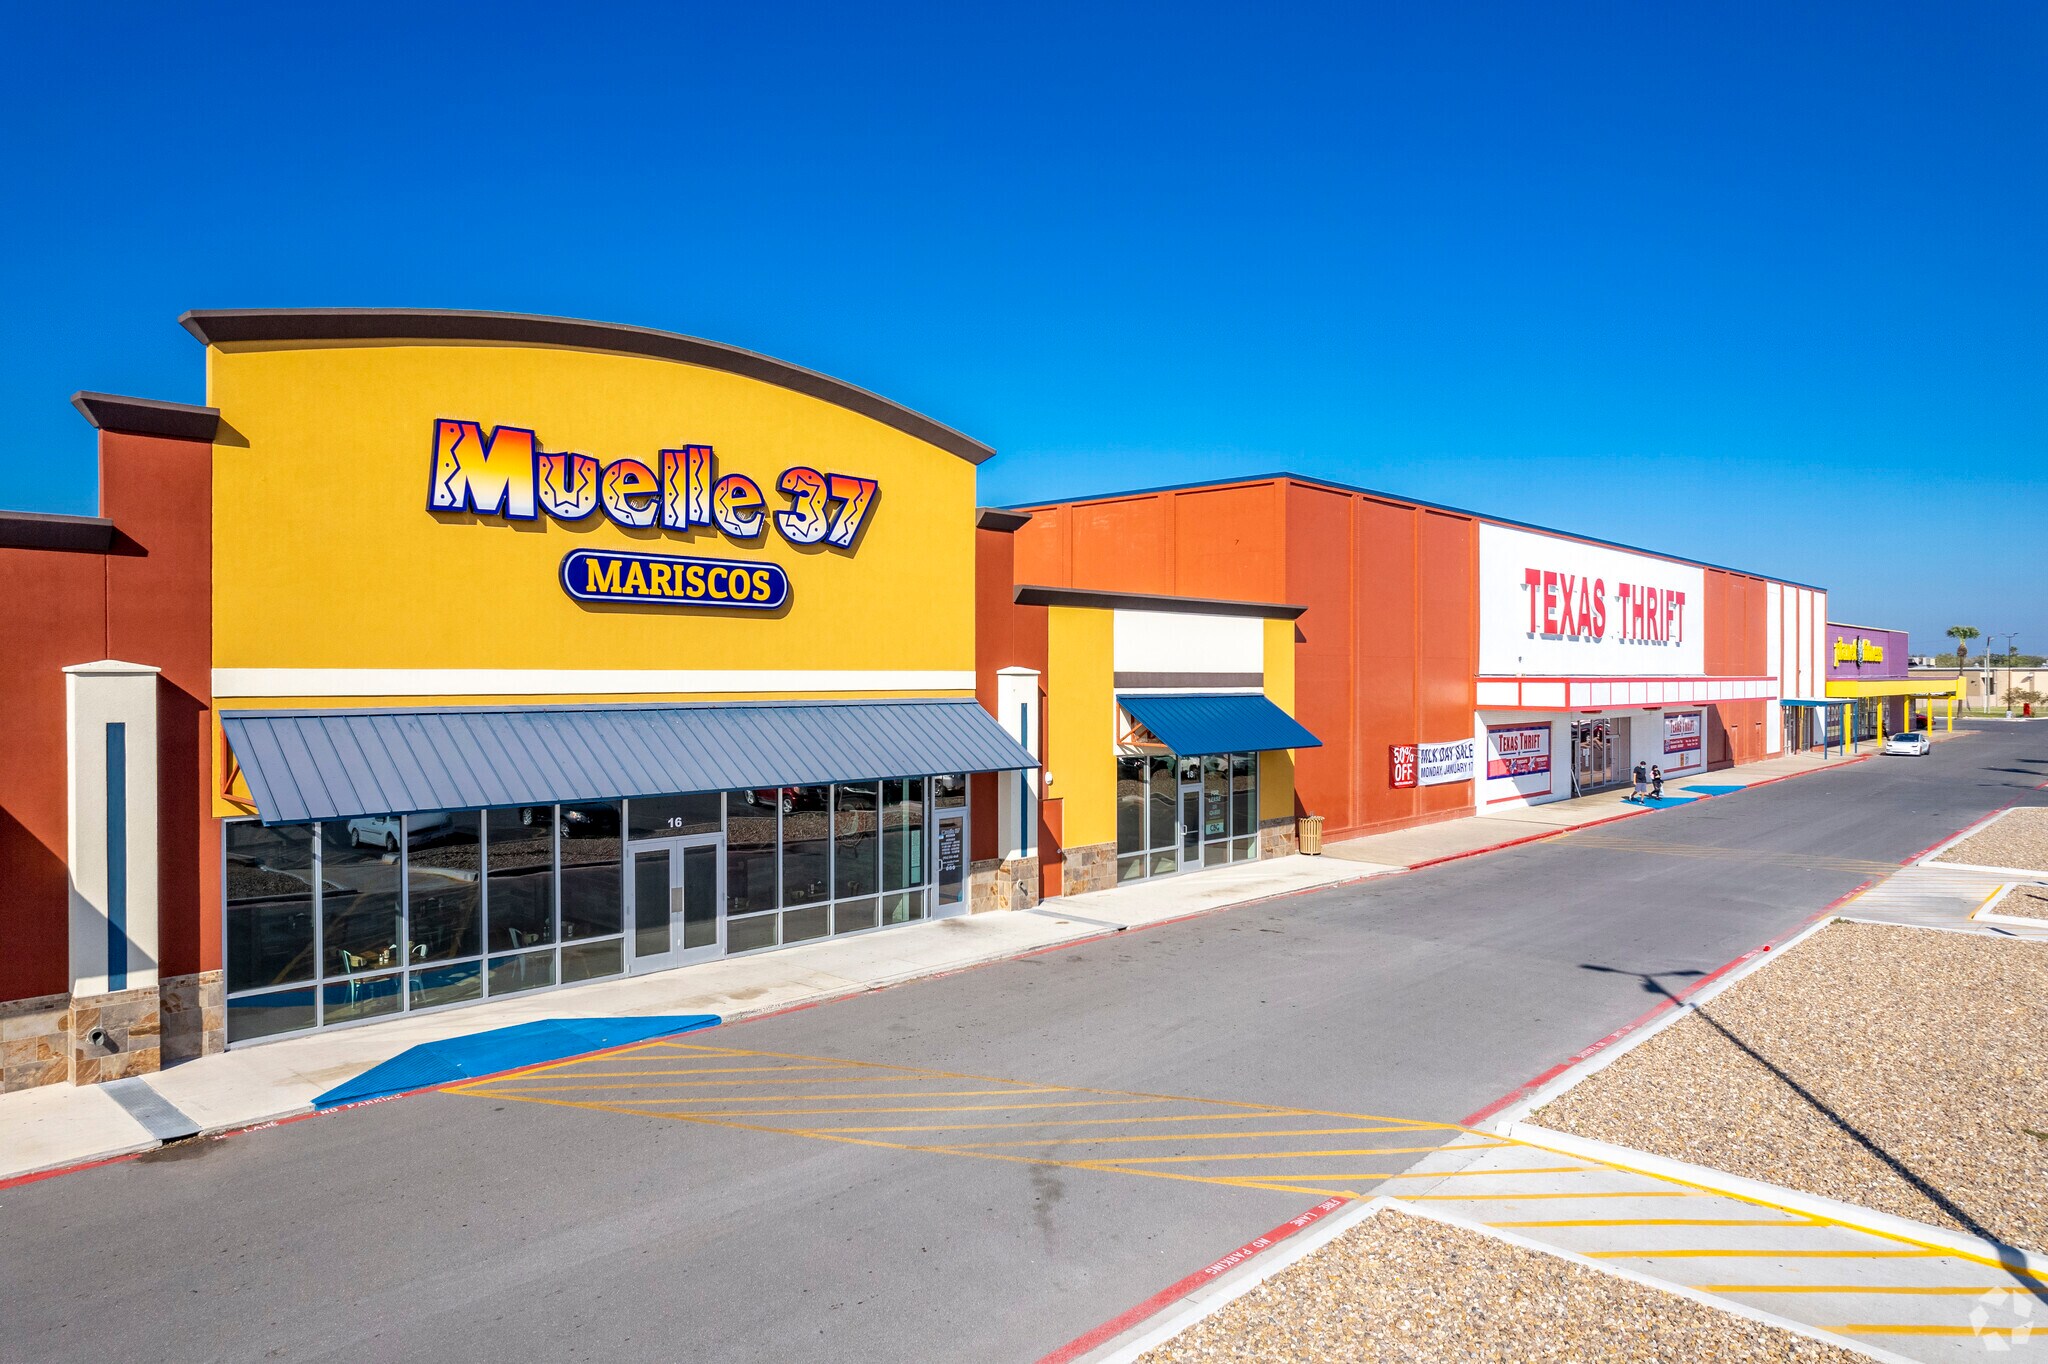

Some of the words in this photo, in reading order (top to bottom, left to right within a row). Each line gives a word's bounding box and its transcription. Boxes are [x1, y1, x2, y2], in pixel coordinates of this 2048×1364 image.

[428, 418, 767, 538] Muelle
[776, 465, 881, 549] 37
[585, 557, 771, 601] MARISCOS
[1525, 567, 1606, 638] TEXAS
[1619, 582, 1686, 643] THRIFT
[1499, 734, 1518, 752] TEXAS
[1520, 732, 1540, 750] THRIFT
[1393, 746, 1414, 764] 50%
[1420, 748, 1438, 764] MLK
[1439, 746, 1454, 762] DAY
[1455, 743, 1473, 760] SALE
[1394, 764, 1413, 781] OFF
[1444, 762, 1468, 775] JANUARY
[667, 816, 683, 828] 16
[1291, 1212, 1317, 1226] LANE
[1253, 1238, 1271, 1248] NO
[1205, 1248, 1253, 1275] PARKING
